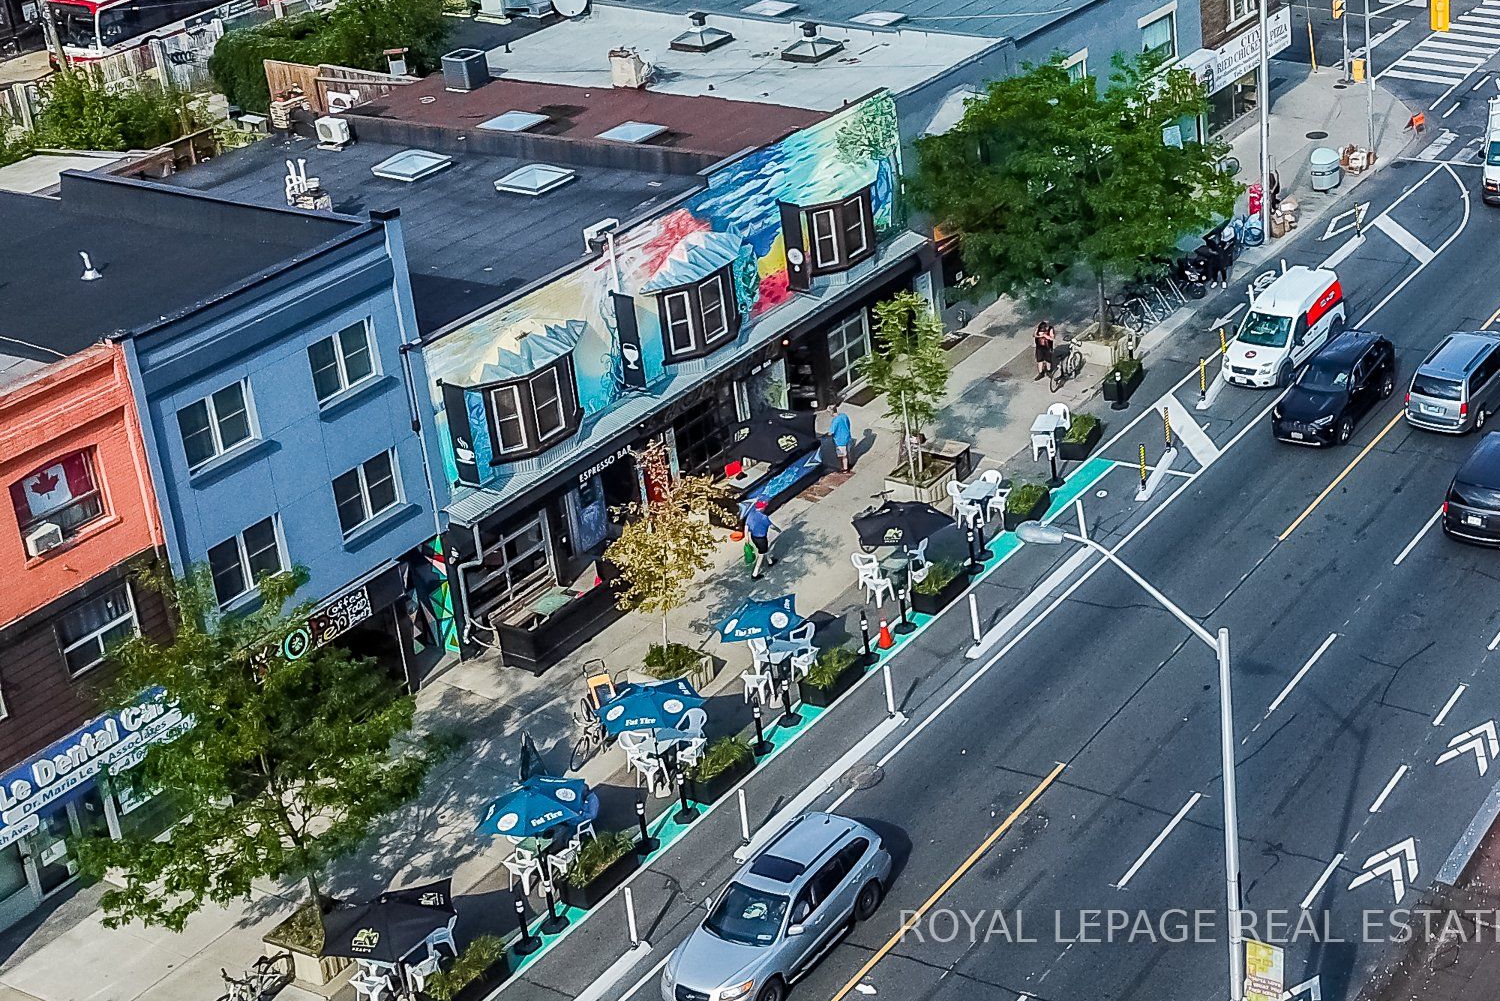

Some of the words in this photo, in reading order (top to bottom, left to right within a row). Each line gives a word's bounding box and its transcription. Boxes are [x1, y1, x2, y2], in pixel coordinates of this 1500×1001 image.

[1235, 41, 1260, 63] CHICKE
[1269, 24, 1287, 40] PIZZA
[1240, 29, 1260, 47] CITY
[579, 455, 615, 483] ESPRESSO
[640, 716, 656, 725] Tire
[32, 718, 120, 788] Dental
[22, 799, 43, 814] Dr.
[42, 778, 78, 802] Maria
[79, 765, 94, 780] Le
[108, 720, 168, 764] Associates
[546, 810, 563, 823] Tire
[11, 822, 33, 839] Ave.
